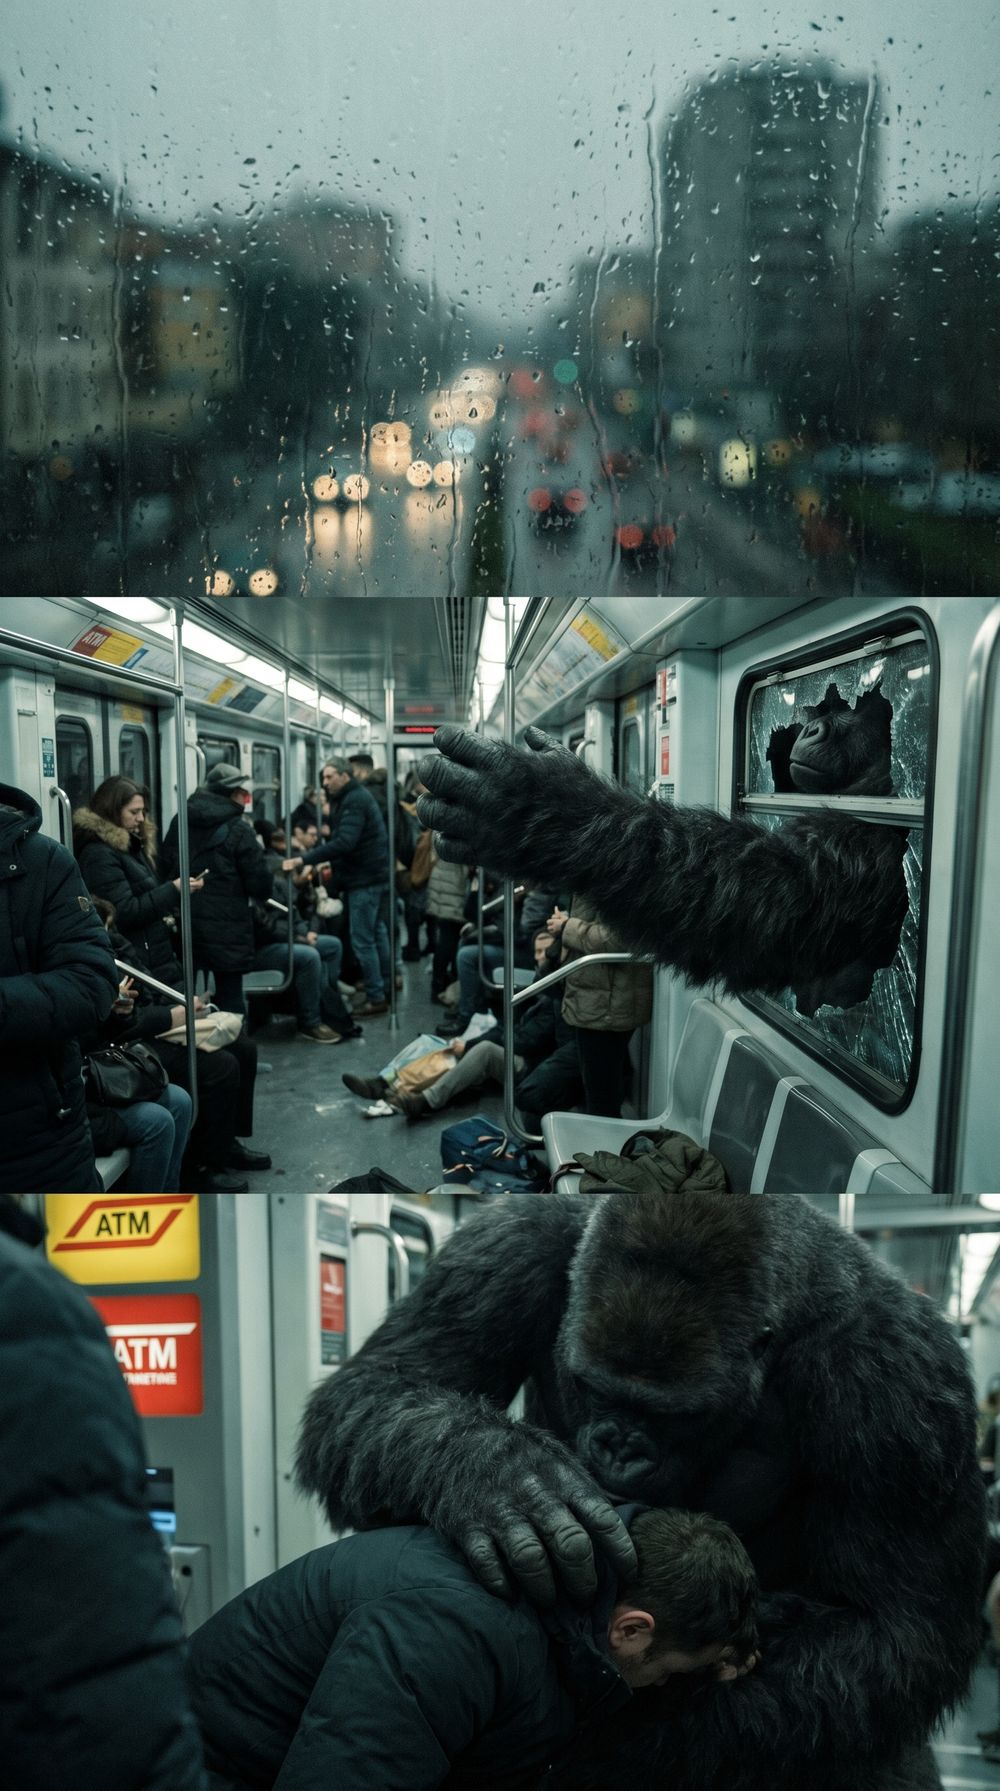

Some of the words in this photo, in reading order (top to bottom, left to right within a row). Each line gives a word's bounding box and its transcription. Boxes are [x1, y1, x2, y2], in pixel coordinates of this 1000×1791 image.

[81, 631, 107, 647] ATM
[96, 1211, 149, 1236] ATM
[114, 1338, 177, 1370] ATM
